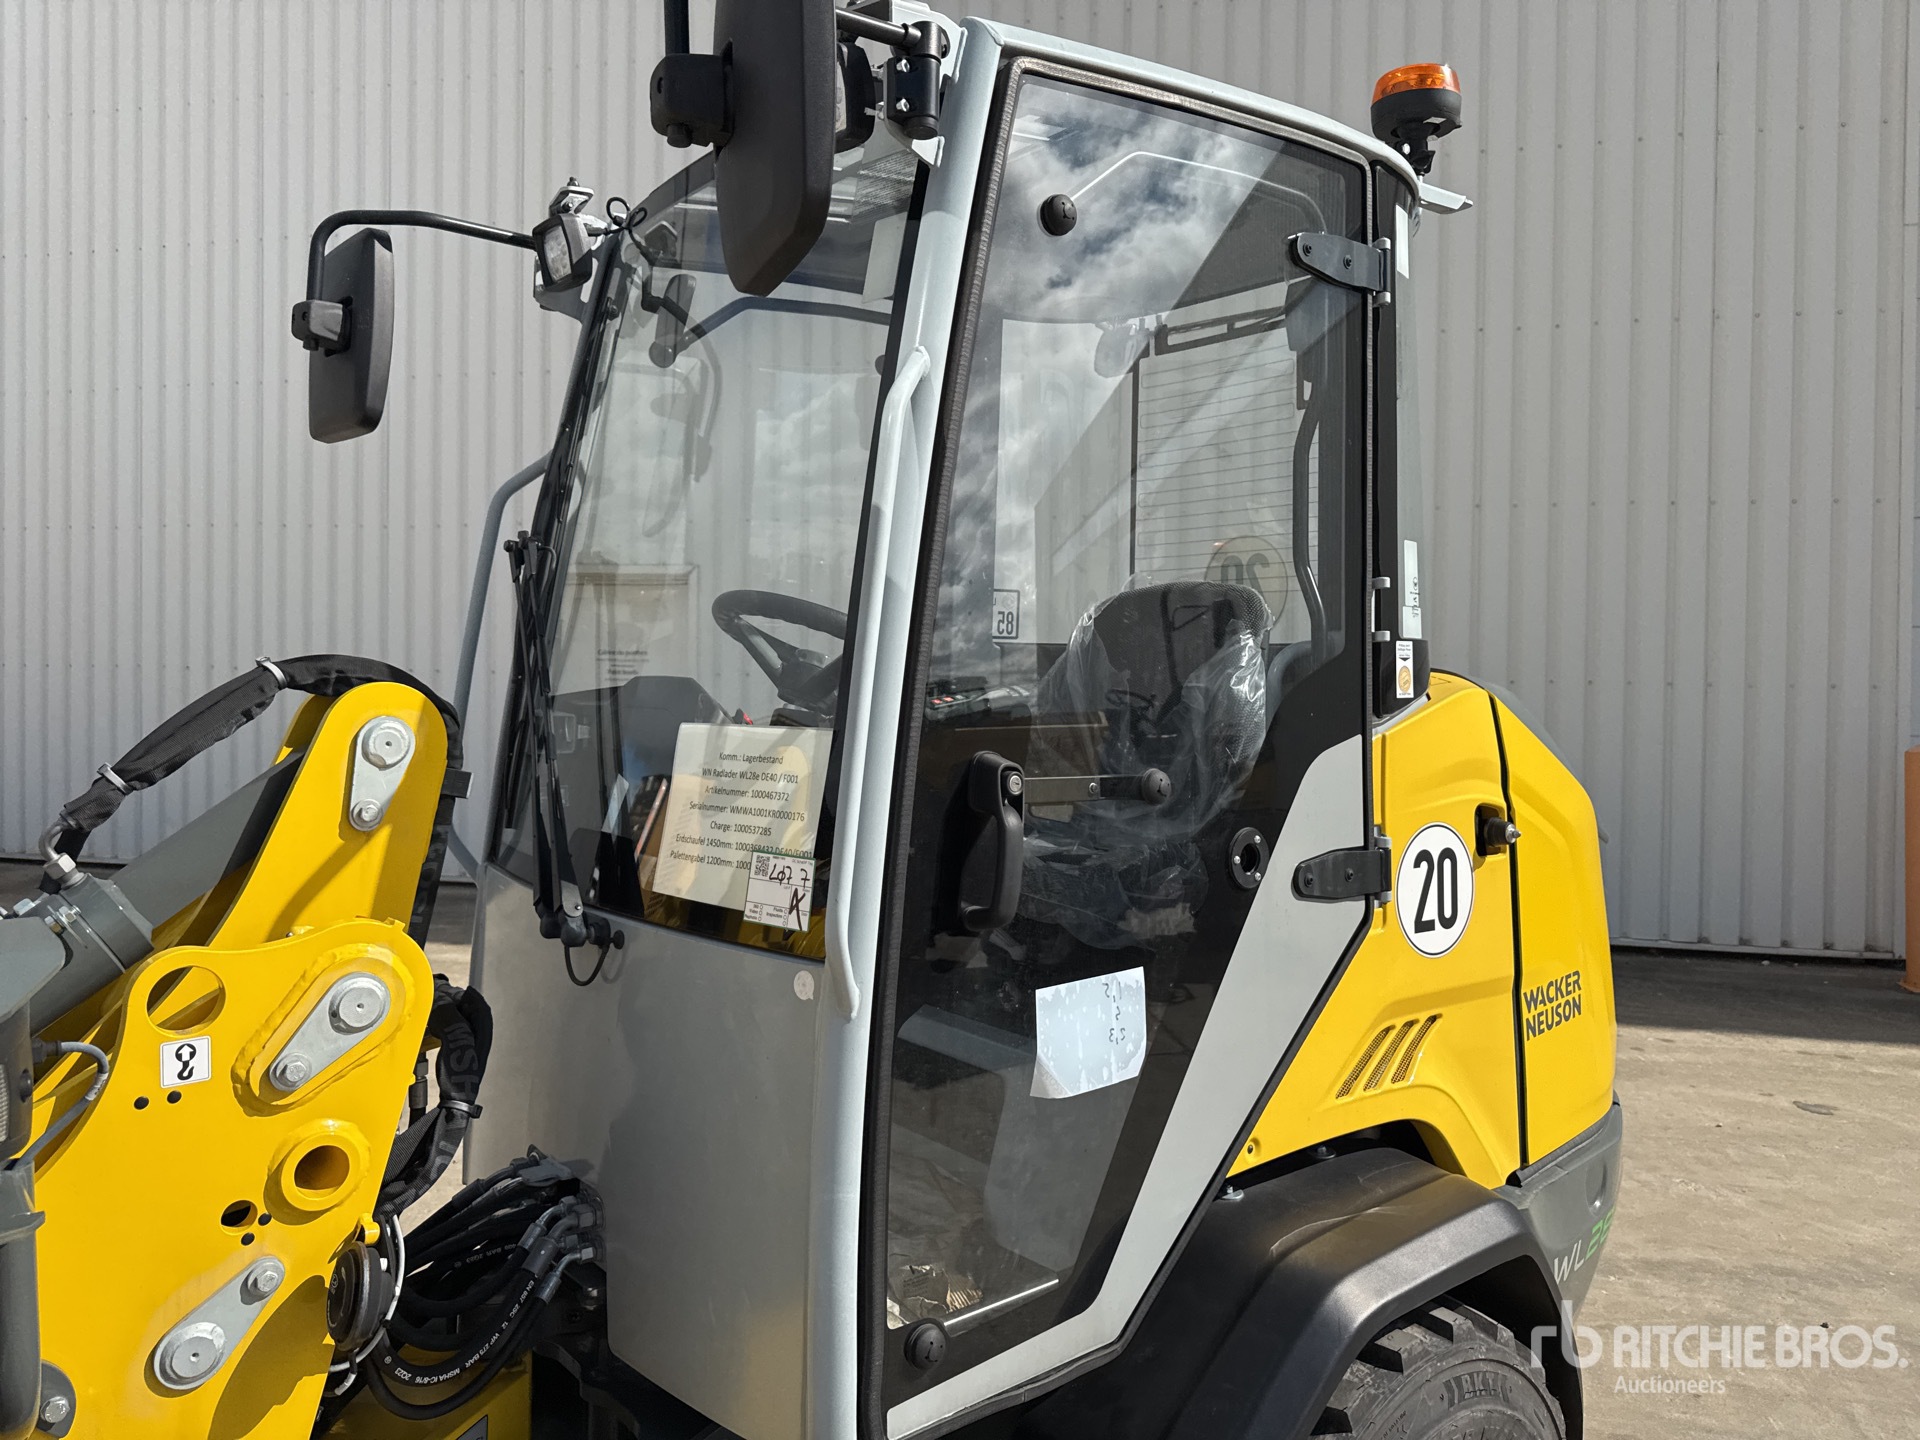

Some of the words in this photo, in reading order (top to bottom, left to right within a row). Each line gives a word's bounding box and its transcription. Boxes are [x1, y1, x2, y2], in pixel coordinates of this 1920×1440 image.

[719, 752, 742, 761] Komm.:
[742, 754, 784, 764] Lagerbestand
[702, 768, 713, 776] WN
[713, 768, 738, 778] Radlader
[739, 771, 760, 781] WL28e
[761, 772, 778, 782] DE40
[783, 774, 799, 784] F001
[704, 785, 750, 798] Artikelnummer:
[751, 789, 790, 801] 1000467372
[689, 801, 728, 813] Serialnummer:
[710, 820, 733, 832] Charge:
[734, 823, 772, 836] 1000537285
[675, 833, 706, 846] Erdschaufel
[706, 838, 734, 849] 1450mm:
[670, 850, 706, 864] Palettengabel
[706, 856, 735, 868] 1200mm:
[736, 860, 751, 871] 1000
[1413, 847, 1458, 934] 20
[1523, 970, 1582, 1014] WACKER
[1525, 994, 1582, 1041] NEUSON
[465, 1353, 480, 1368] BAR
[439, 1367, 460, 1382] MSHA
